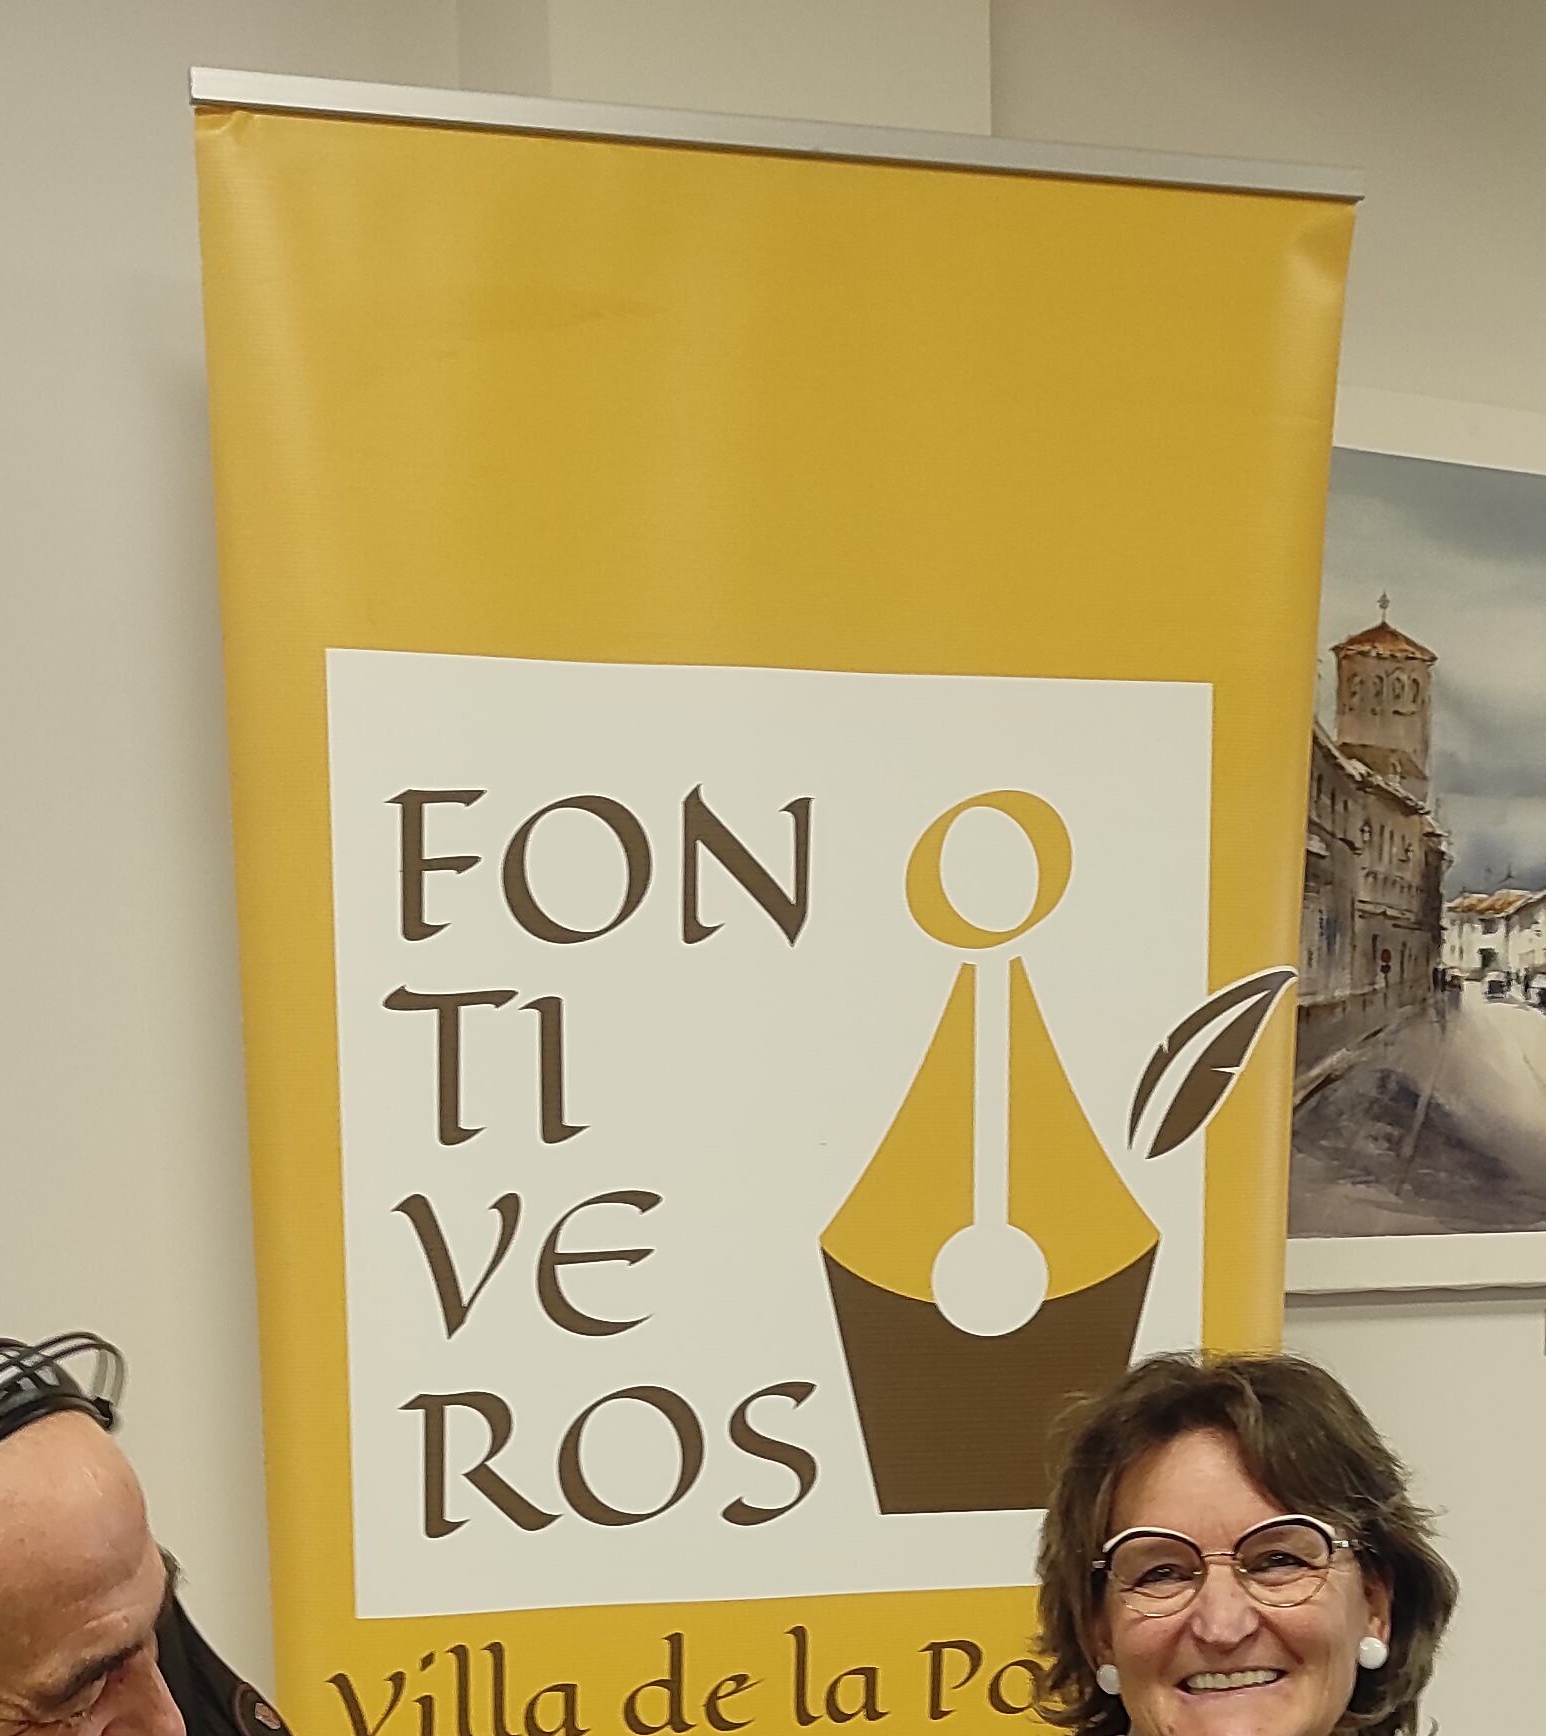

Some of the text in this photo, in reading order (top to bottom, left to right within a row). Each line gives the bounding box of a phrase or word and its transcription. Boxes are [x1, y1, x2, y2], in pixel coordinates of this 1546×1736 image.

[384, 783, 815, 947] FON
[381, 984, 592, 1146] TI
[390, 1189, 664, 1340] VE
[395, 1380, 819, 1539] ROS
[623, 1631, 767, 1736] de
[784, 1624, 890, 1728] la
